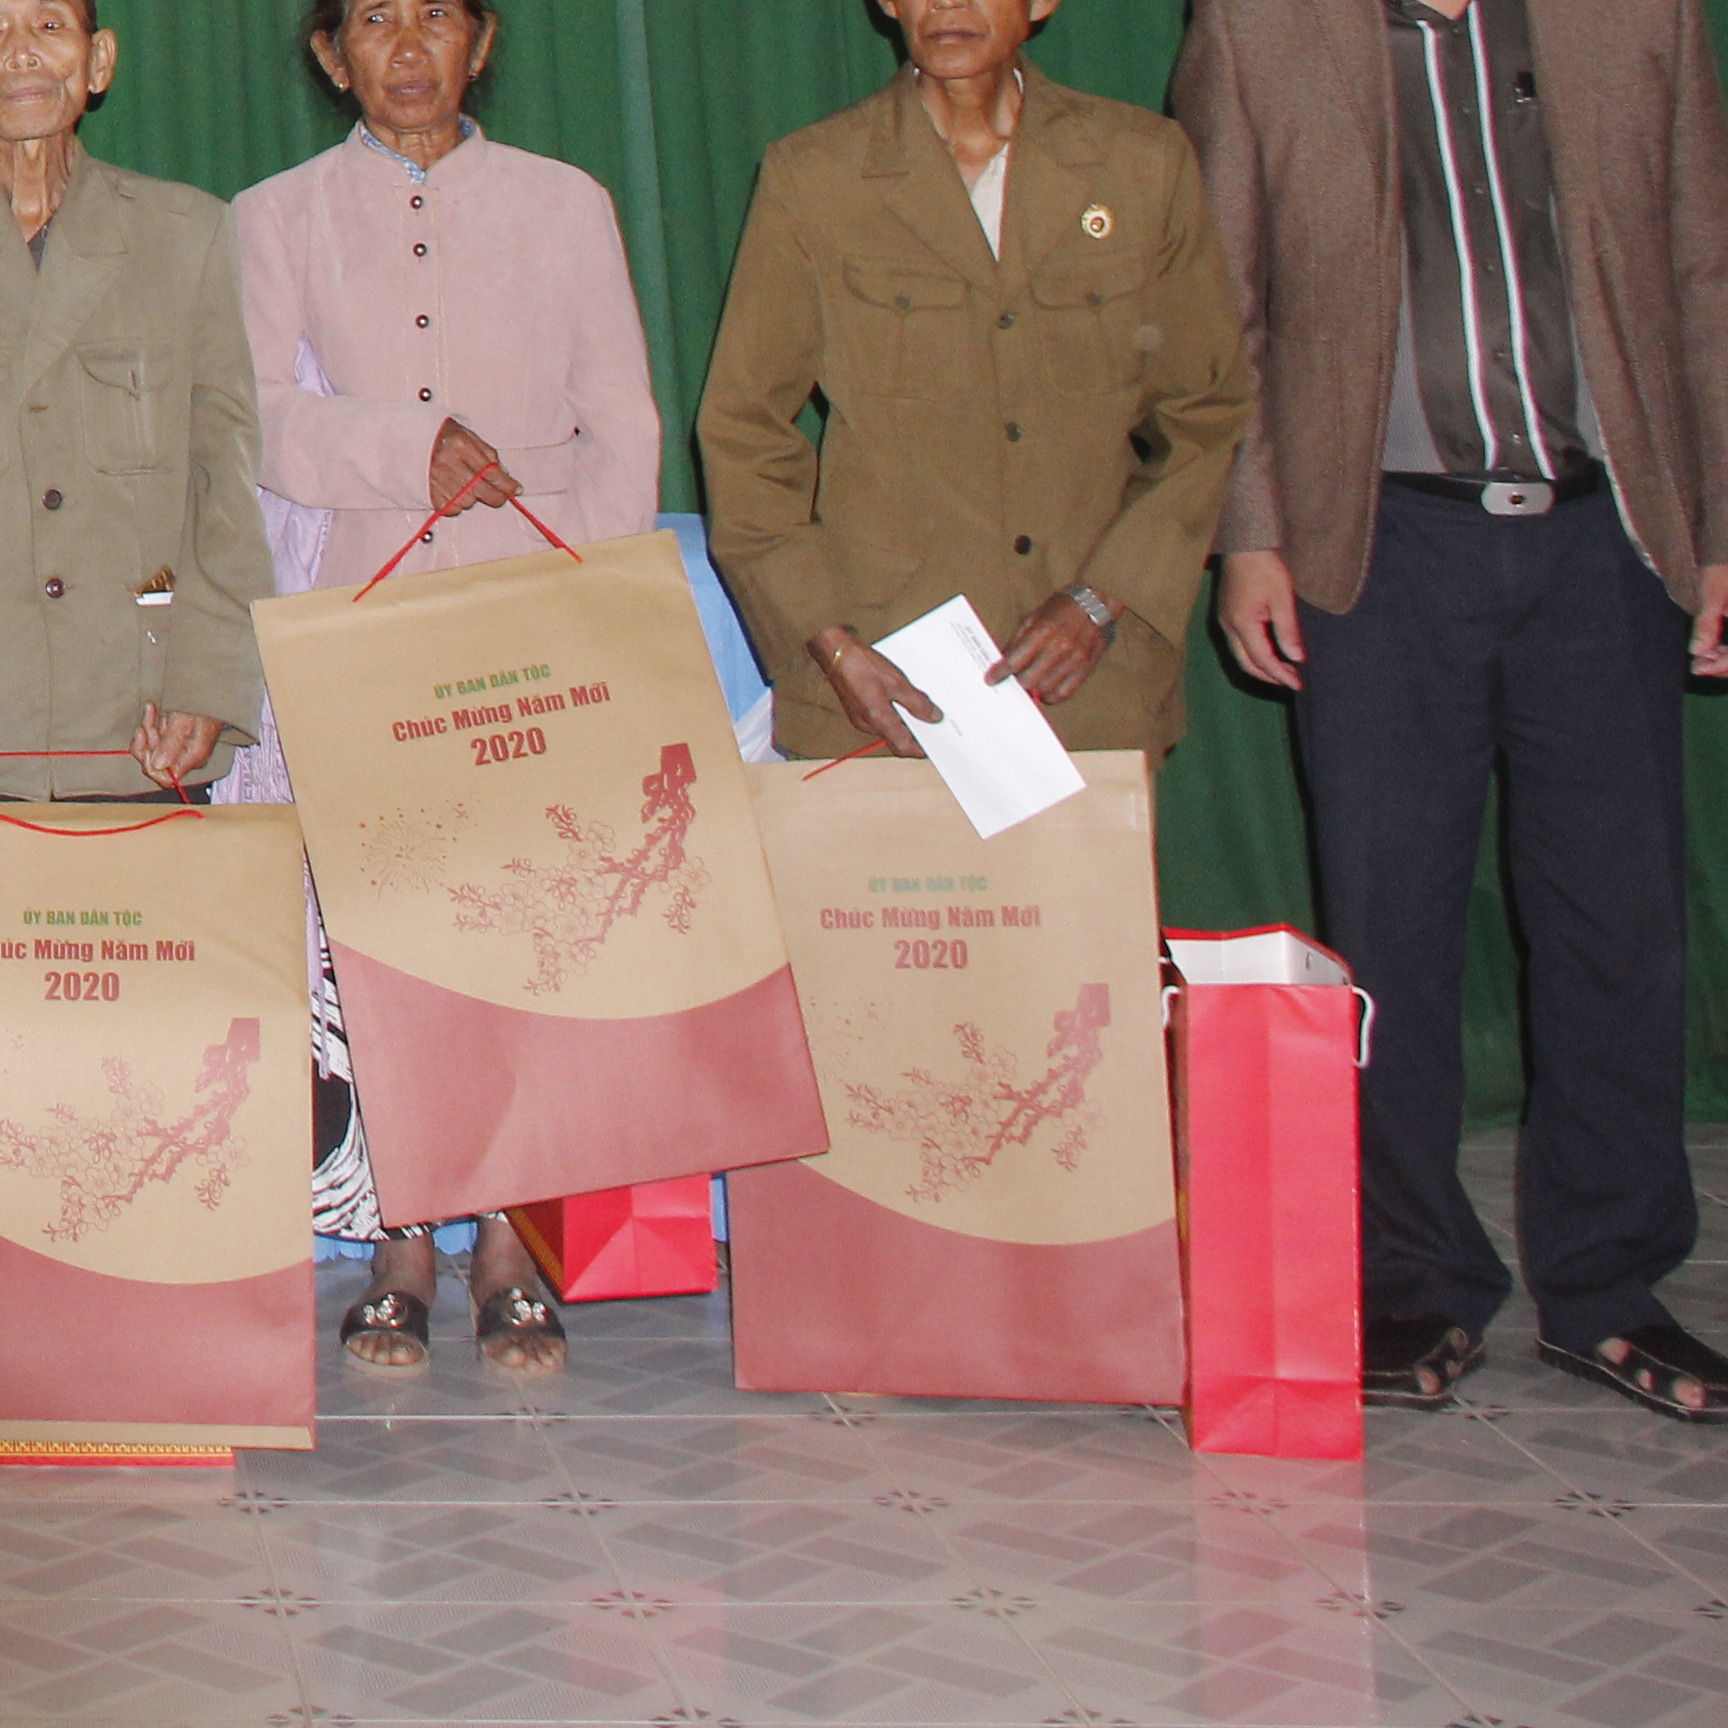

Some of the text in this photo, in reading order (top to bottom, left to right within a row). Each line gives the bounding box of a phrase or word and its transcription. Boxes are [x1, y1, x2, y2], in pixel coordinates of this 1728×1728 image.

[392, 682, 610, 741] Chúc Mừng Năm Mới
[471, 727, 546, 765] 2020
[34, 939, 93, 962] Mừng
[101, 940, 149, 960] Năm
[156, 940, 195, 960] Mới
[894, 939, 968, 968] 2020
[45, 972, 119, 1000] 2020
